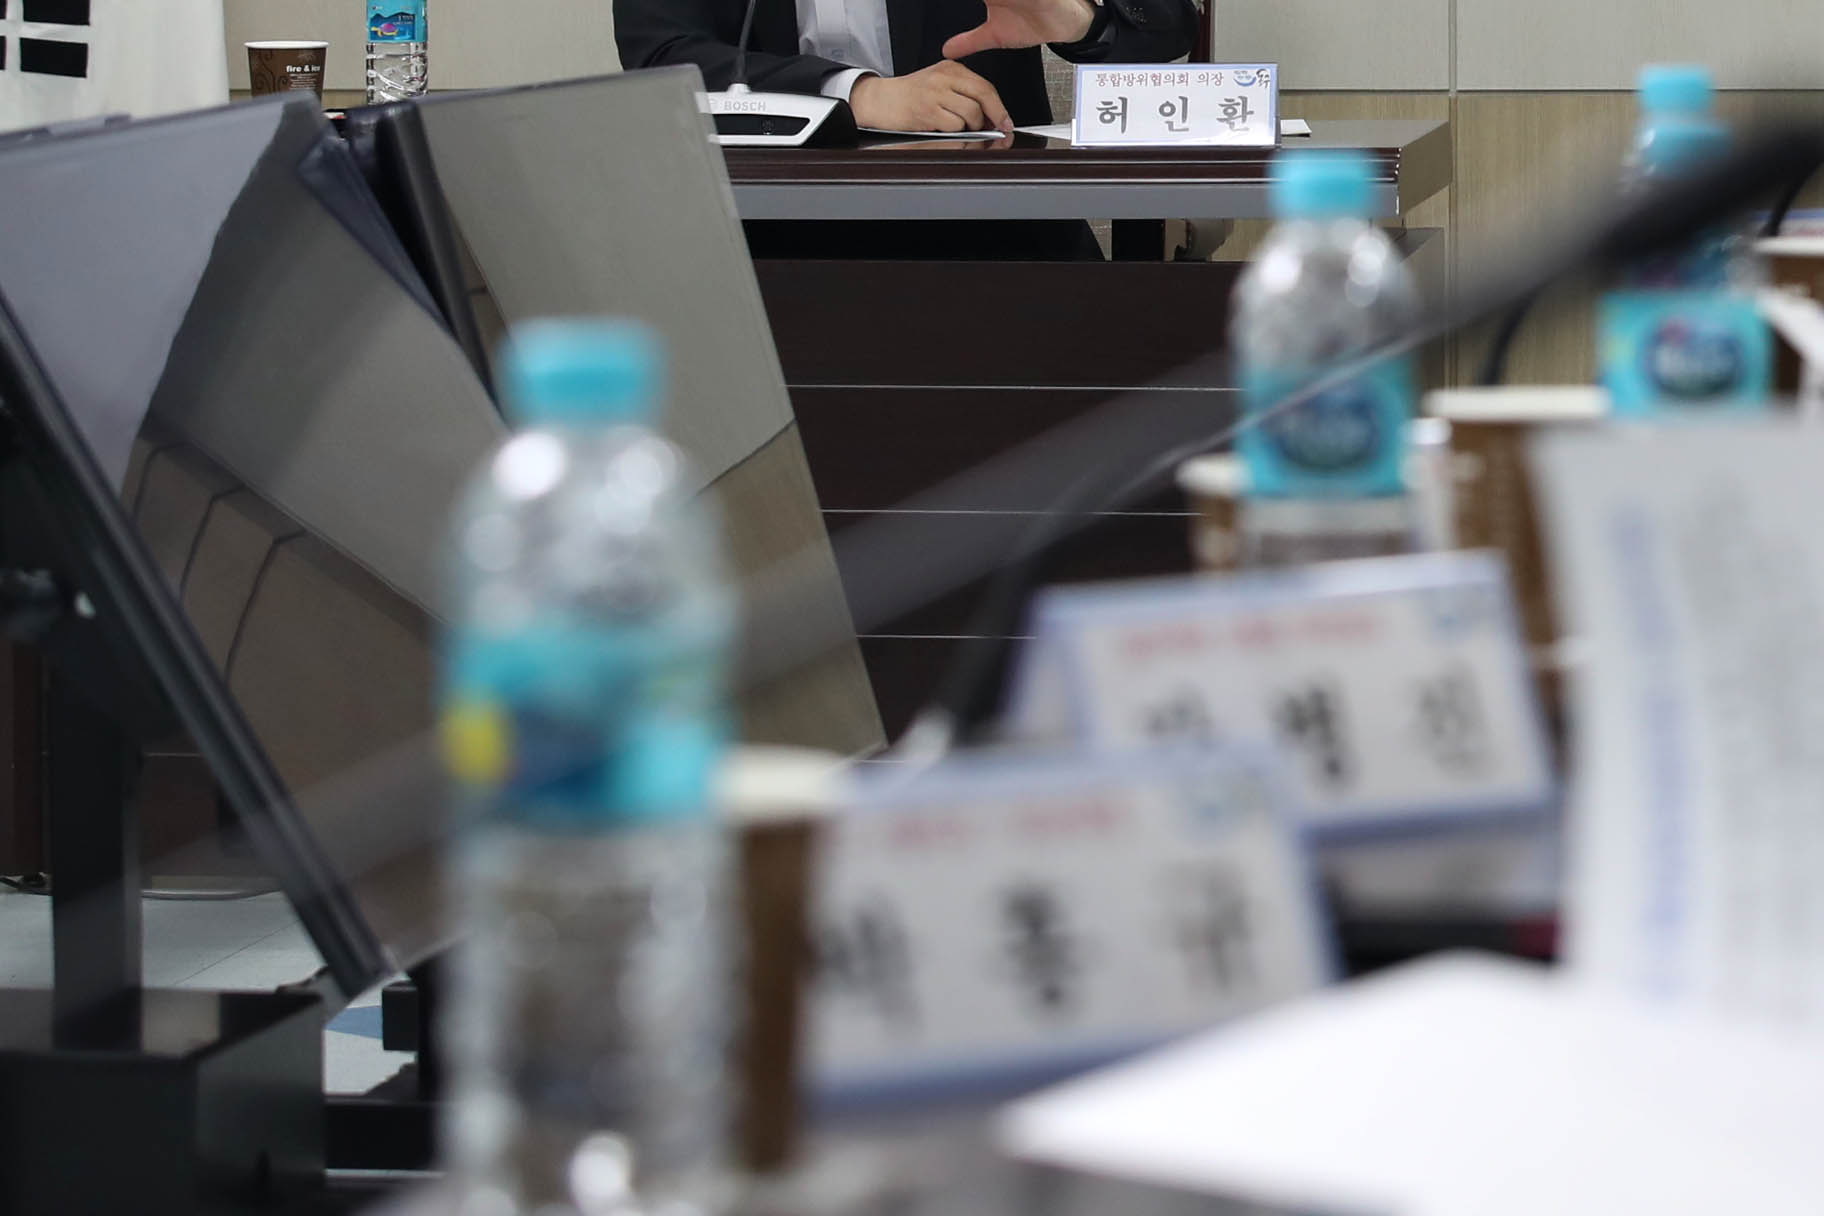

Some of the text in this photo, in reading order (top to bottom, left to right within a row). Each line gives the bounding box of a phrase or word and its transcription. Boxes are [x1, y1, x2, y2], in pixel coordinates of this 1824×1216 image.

[1096, 72, 1189, 88] 통합방위협의회
[722, 101, 767, 112] BOSCH
[1096, 95, 1255, 134] 허 인 환
